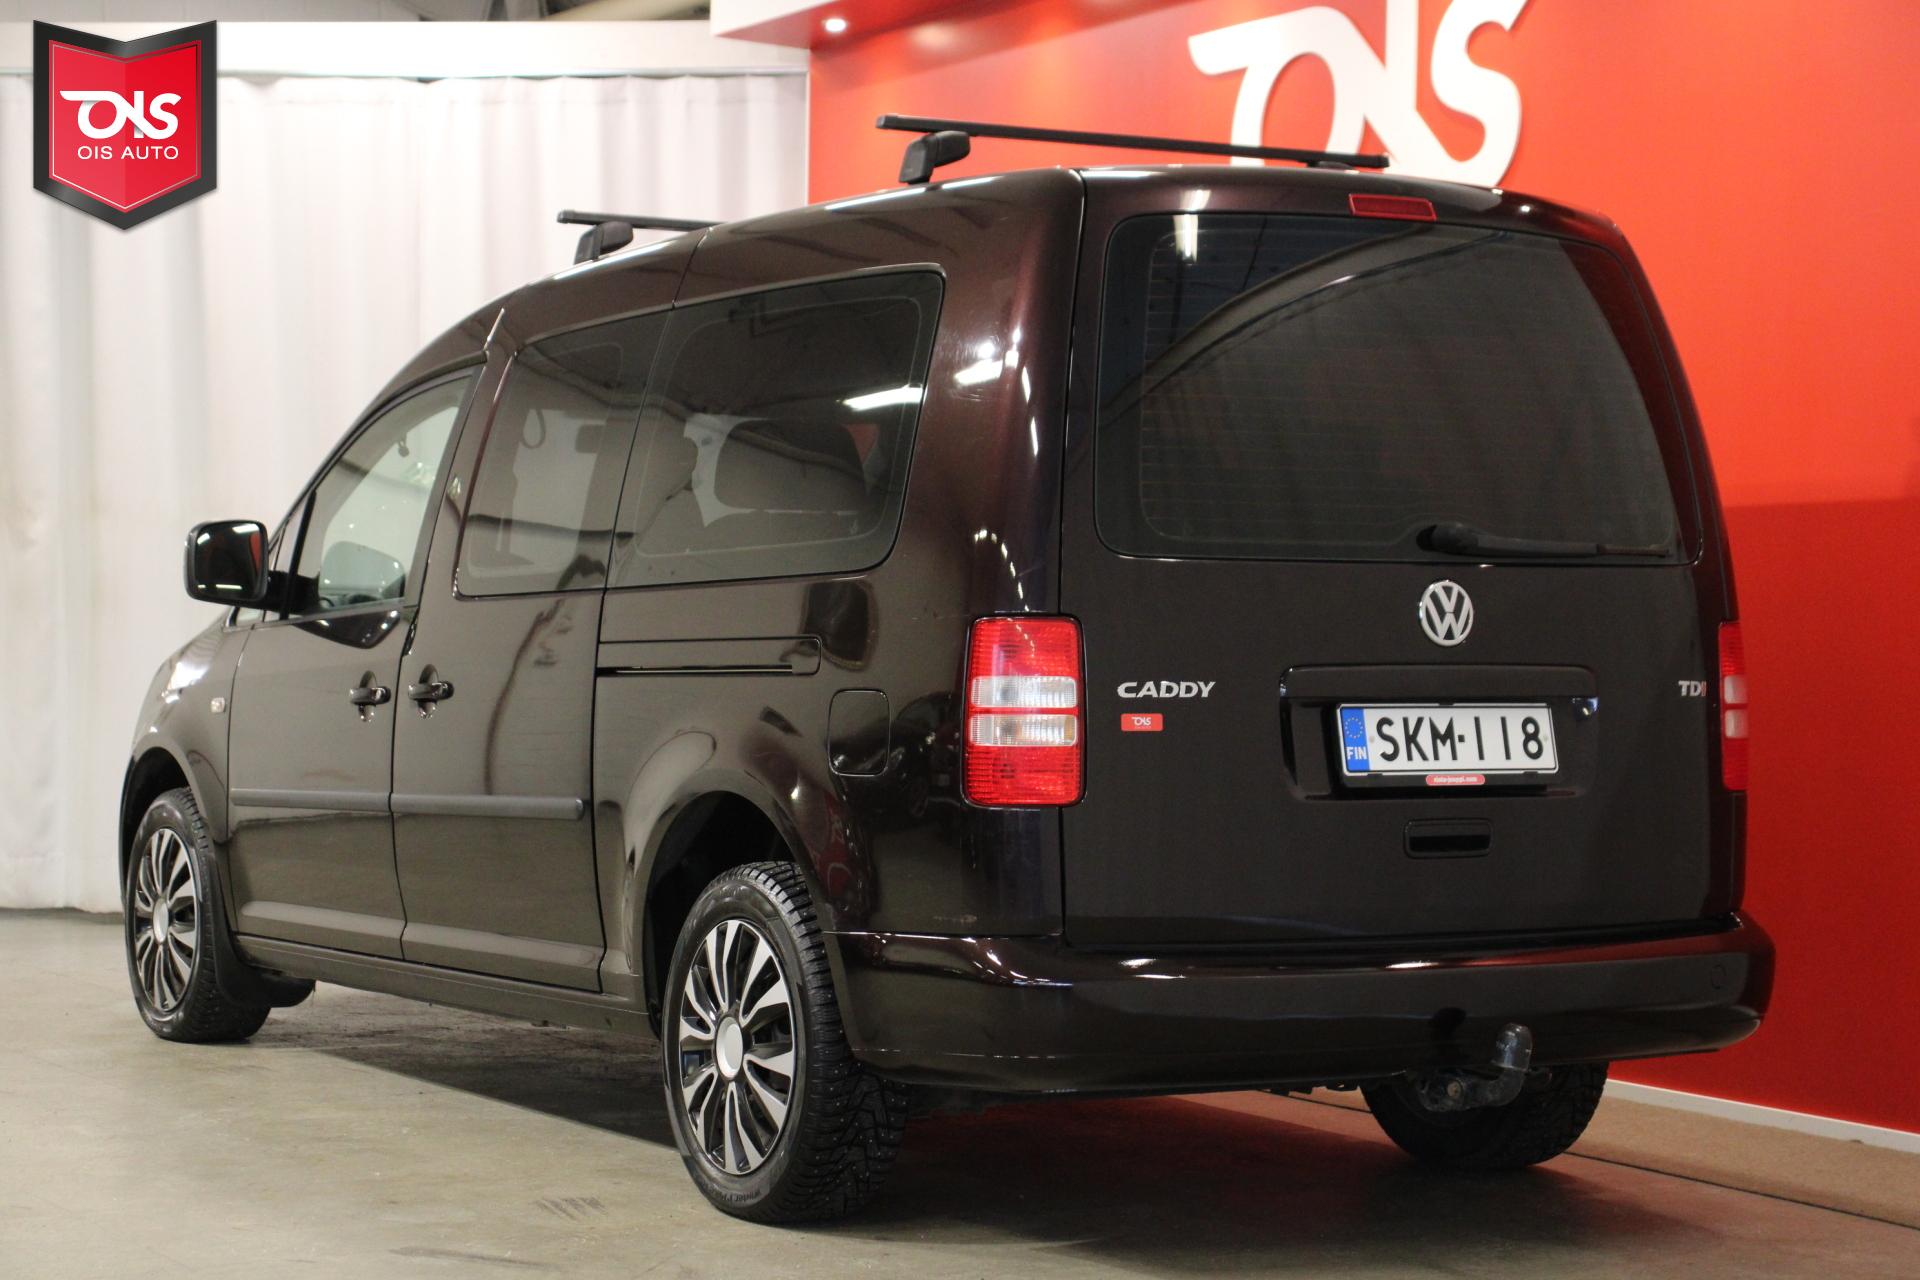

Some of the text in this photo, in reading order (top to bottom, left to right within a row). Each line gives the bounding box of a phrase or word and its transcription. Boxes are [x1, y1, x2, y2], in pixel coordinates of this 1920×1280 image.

[1116, 680, 1216, 698] CADDY
[1376, 715, 1544, 762] SKM-118
[1346, 746, 1367, 760] FIN
